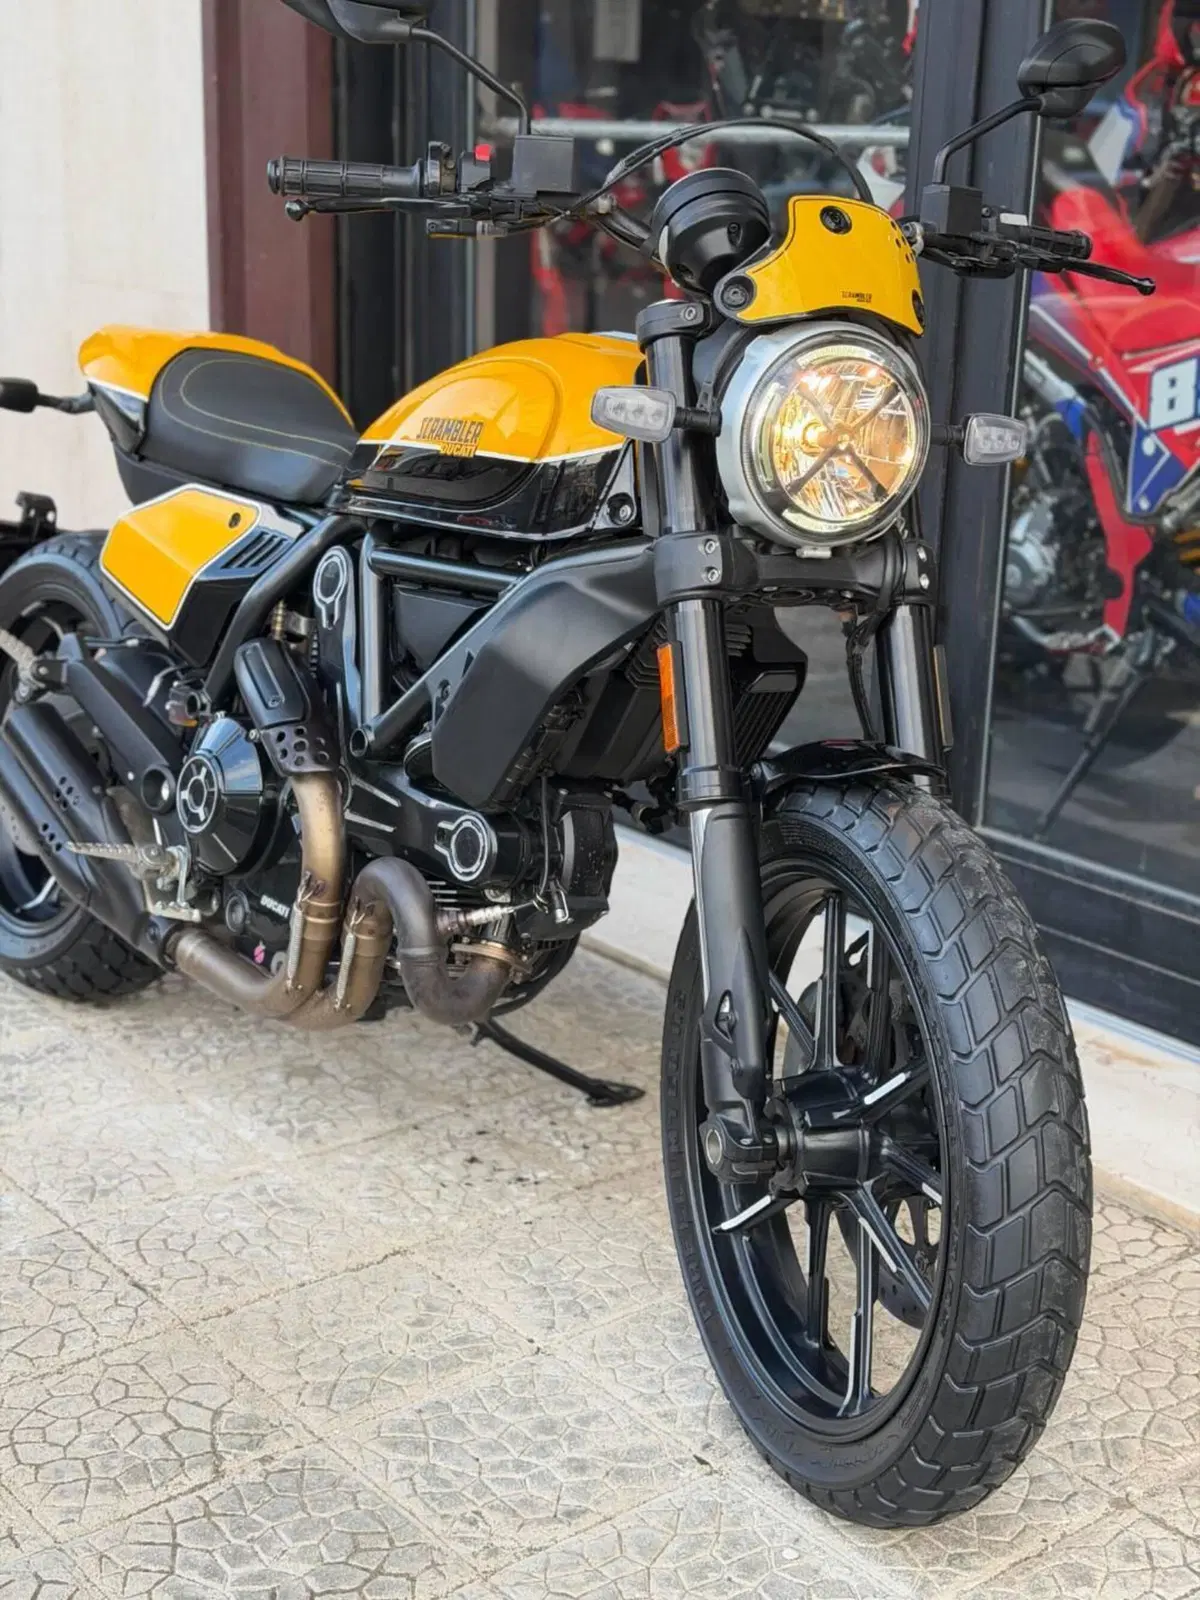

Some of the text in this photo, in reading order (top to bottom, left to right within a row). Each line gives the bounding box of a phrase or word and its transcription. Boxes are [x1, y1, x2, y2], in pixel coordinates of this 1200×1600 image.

[416, 416, 484, 443] SCRAMBLER
[441, 442, 477, 458] DUCATI
[260, 894, 291, 918] DUCATI
